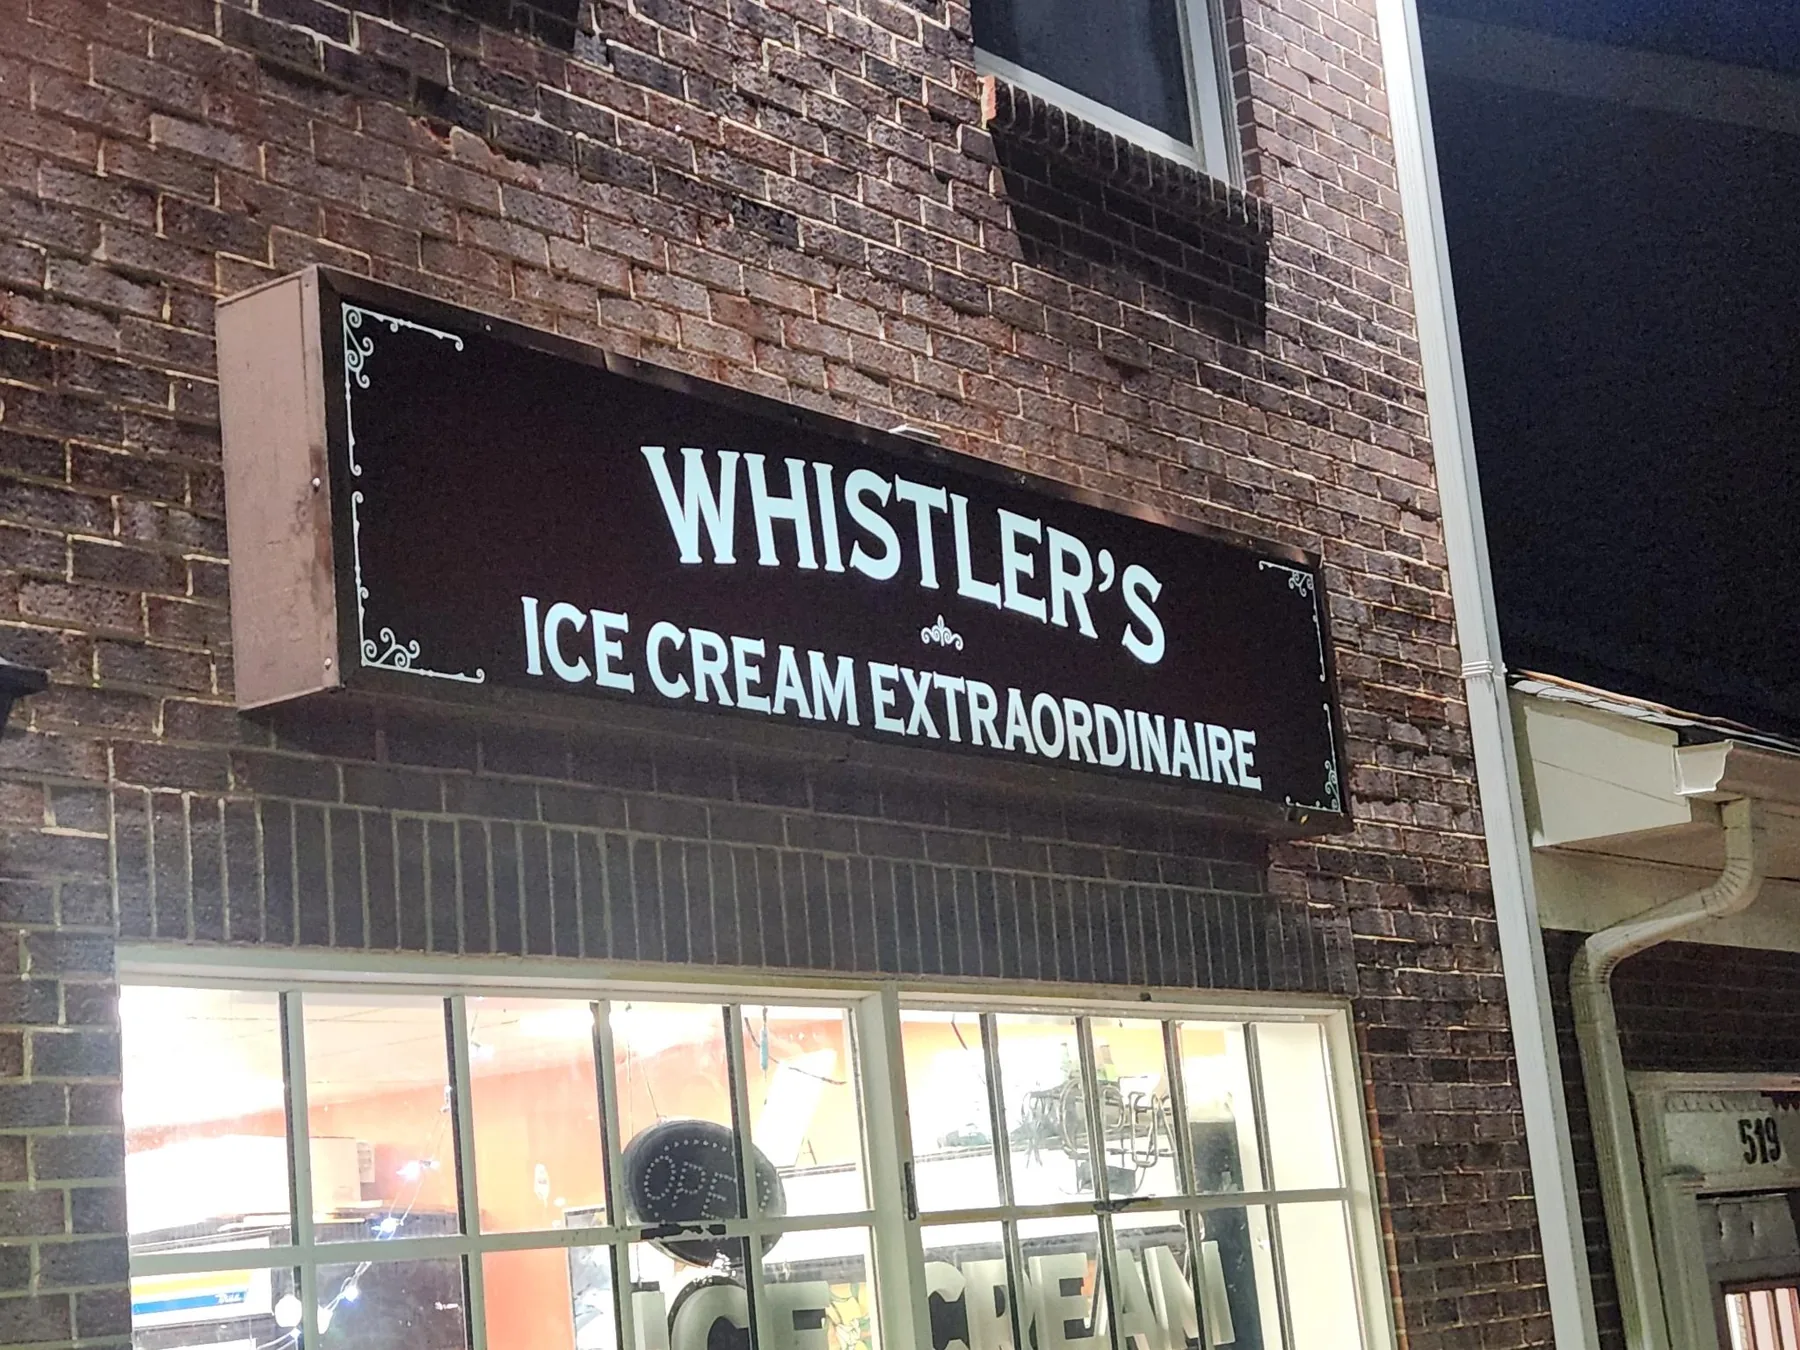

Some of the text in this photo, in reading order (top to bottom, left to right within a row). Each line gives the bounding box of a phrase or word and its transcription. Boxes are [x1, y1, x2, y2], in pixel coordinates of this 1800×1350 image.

[640, 446, 1165, 665] WHISTLER'S
[520, 595, 1262, 792] ICE CREAM EXTRAORDINAIRE
[644, 1155, 740, 1220] OPE
[1738, 1116, 1781, 1165] 519
